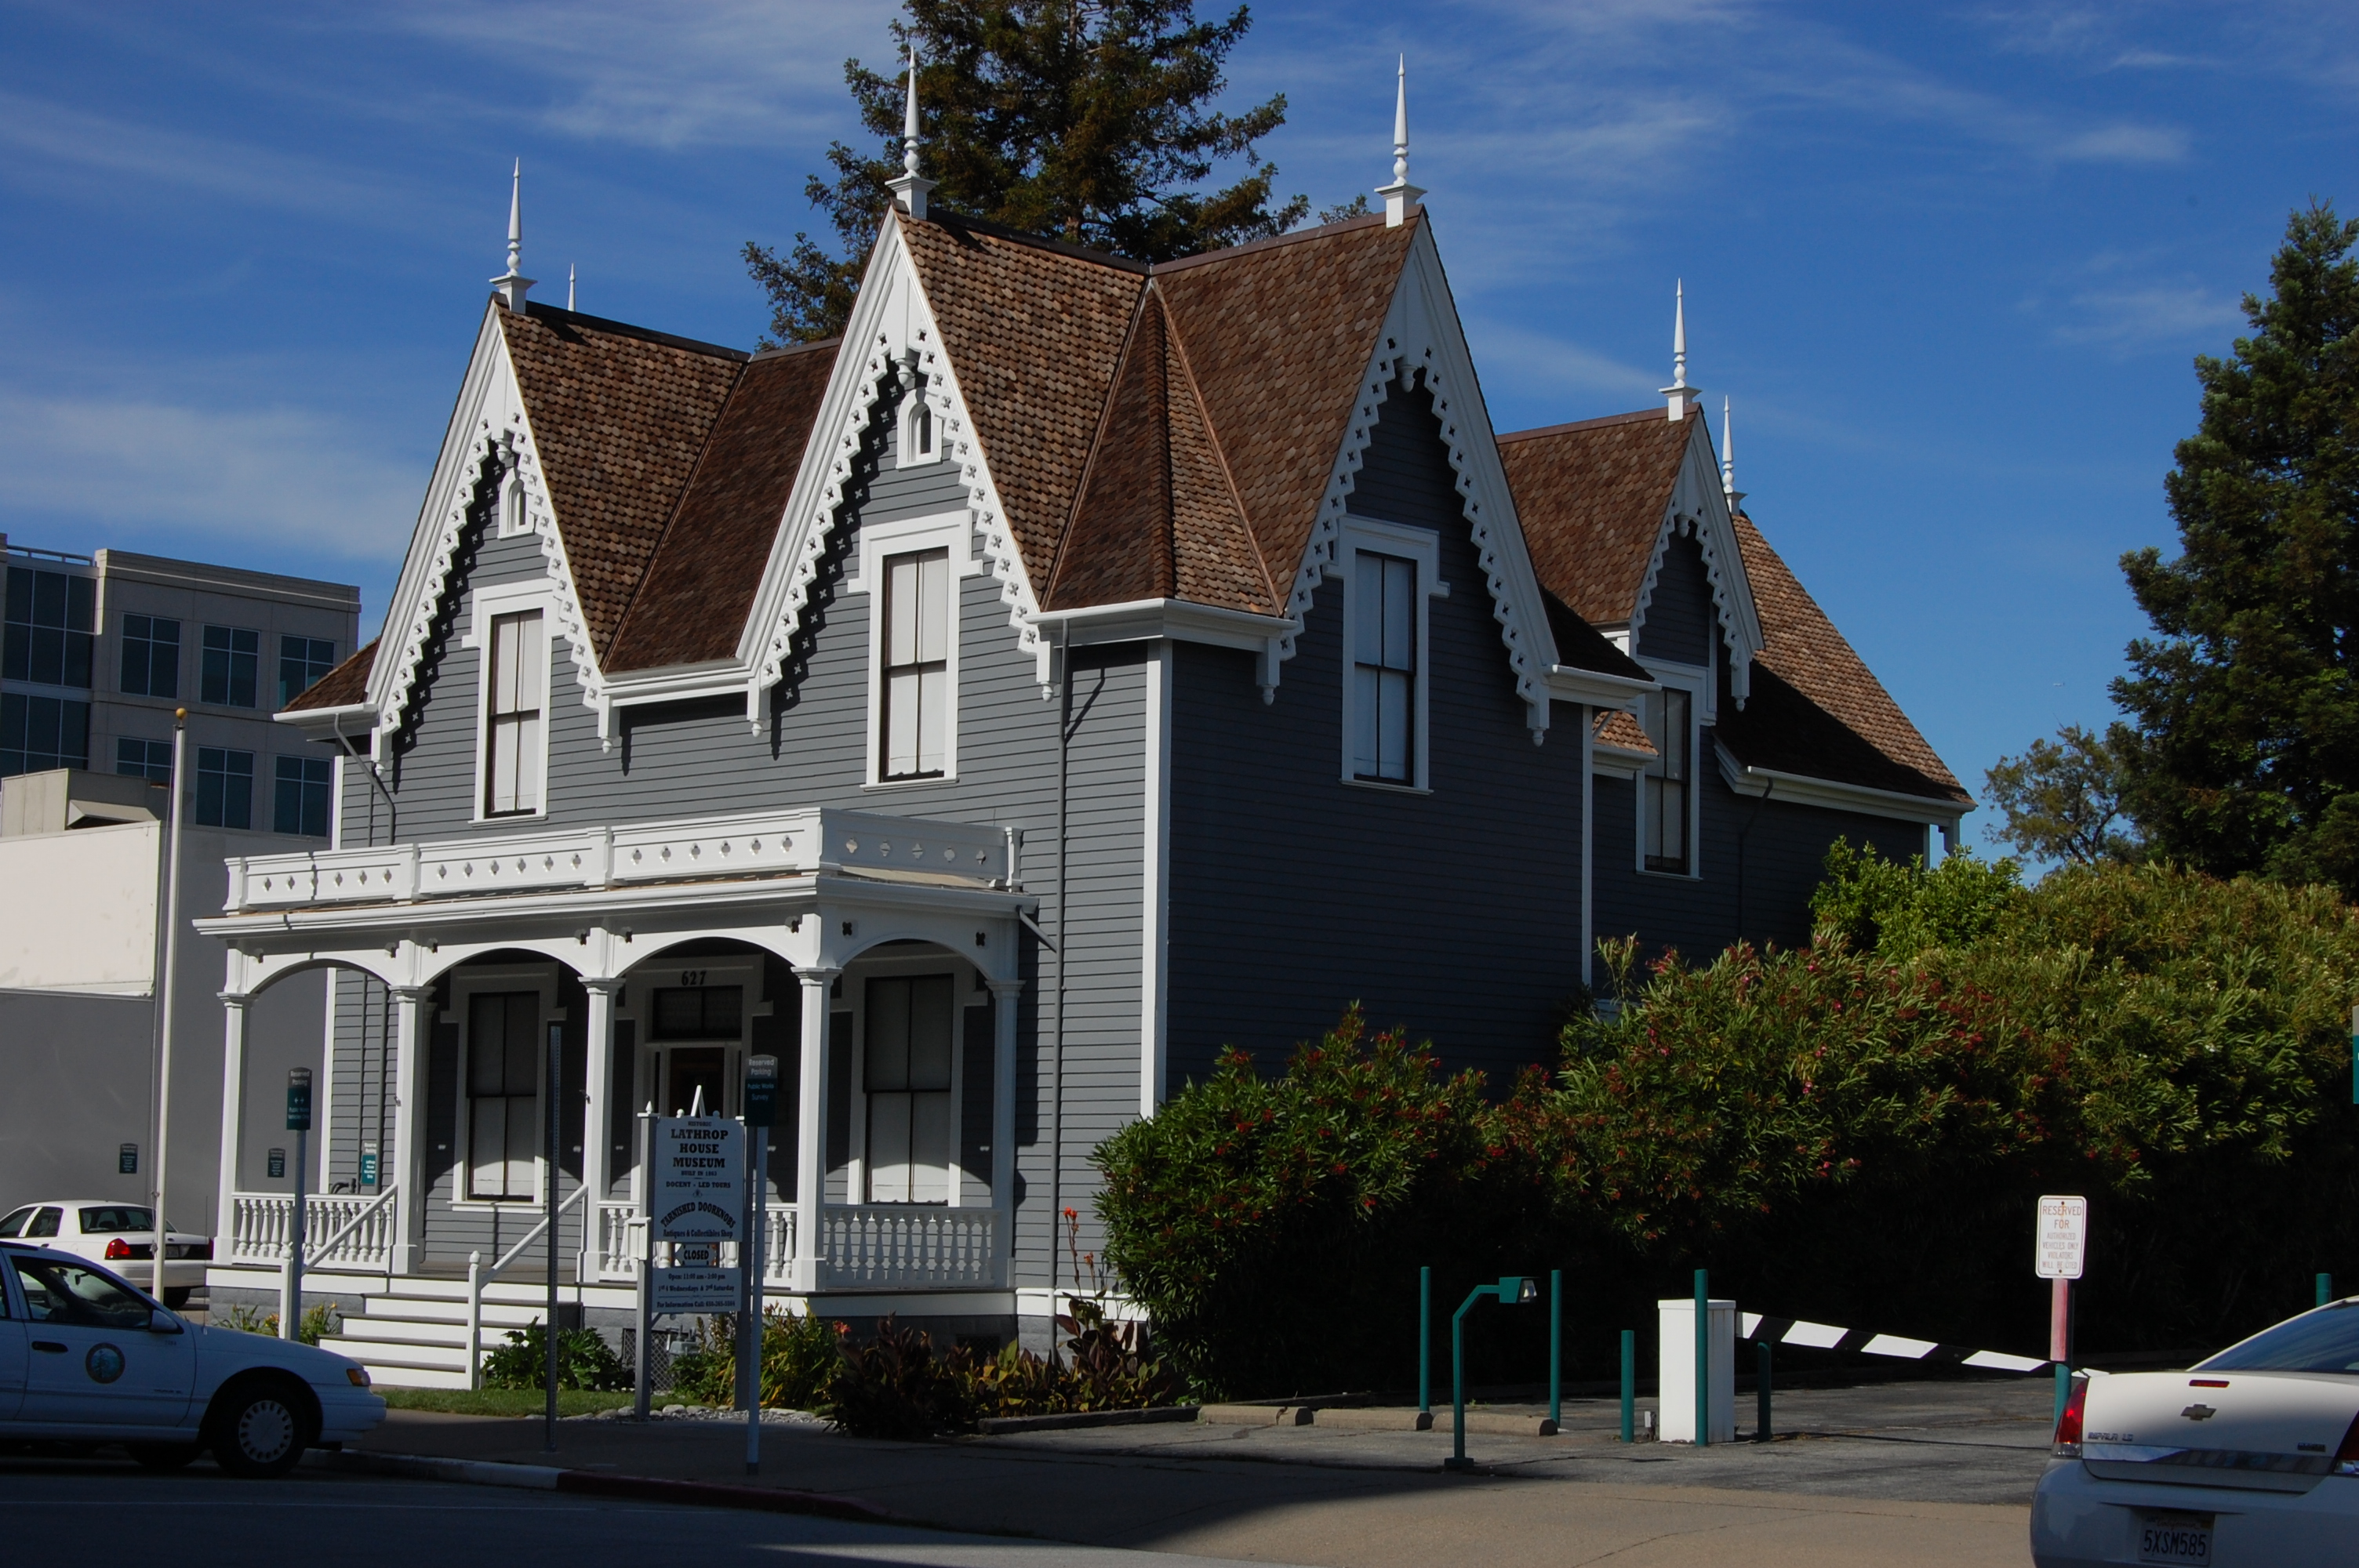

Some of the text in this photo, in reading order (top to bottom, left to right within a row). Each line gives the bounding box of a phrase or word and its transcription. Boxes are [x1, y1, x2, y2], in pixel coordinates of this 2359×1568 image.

[682, 970, 707, 986] 627
[751, 1068, 772, 1076] Parking
[751, 1093, 769, 1102] Survey
[671, 1129, 729, 1140] LATHROP
[679, 1143, 720, 1154] HOUSE
[673, 1157, 726, 1168] MUSEUM
[660, 1201, 736, 1229] TARNISHED DOORKNOBS
[2042, 1206, 2082, 1216] RESERVED
[2054, 1219, 2070, 1229] FOR
[663, 1229, 685, 1239] Antiques
[721, 1229, 733, 1239] Shop
[684, 1250, 709, 1260] CLOSED
[2143, 1530, 2207, 1557] 5XSM585
